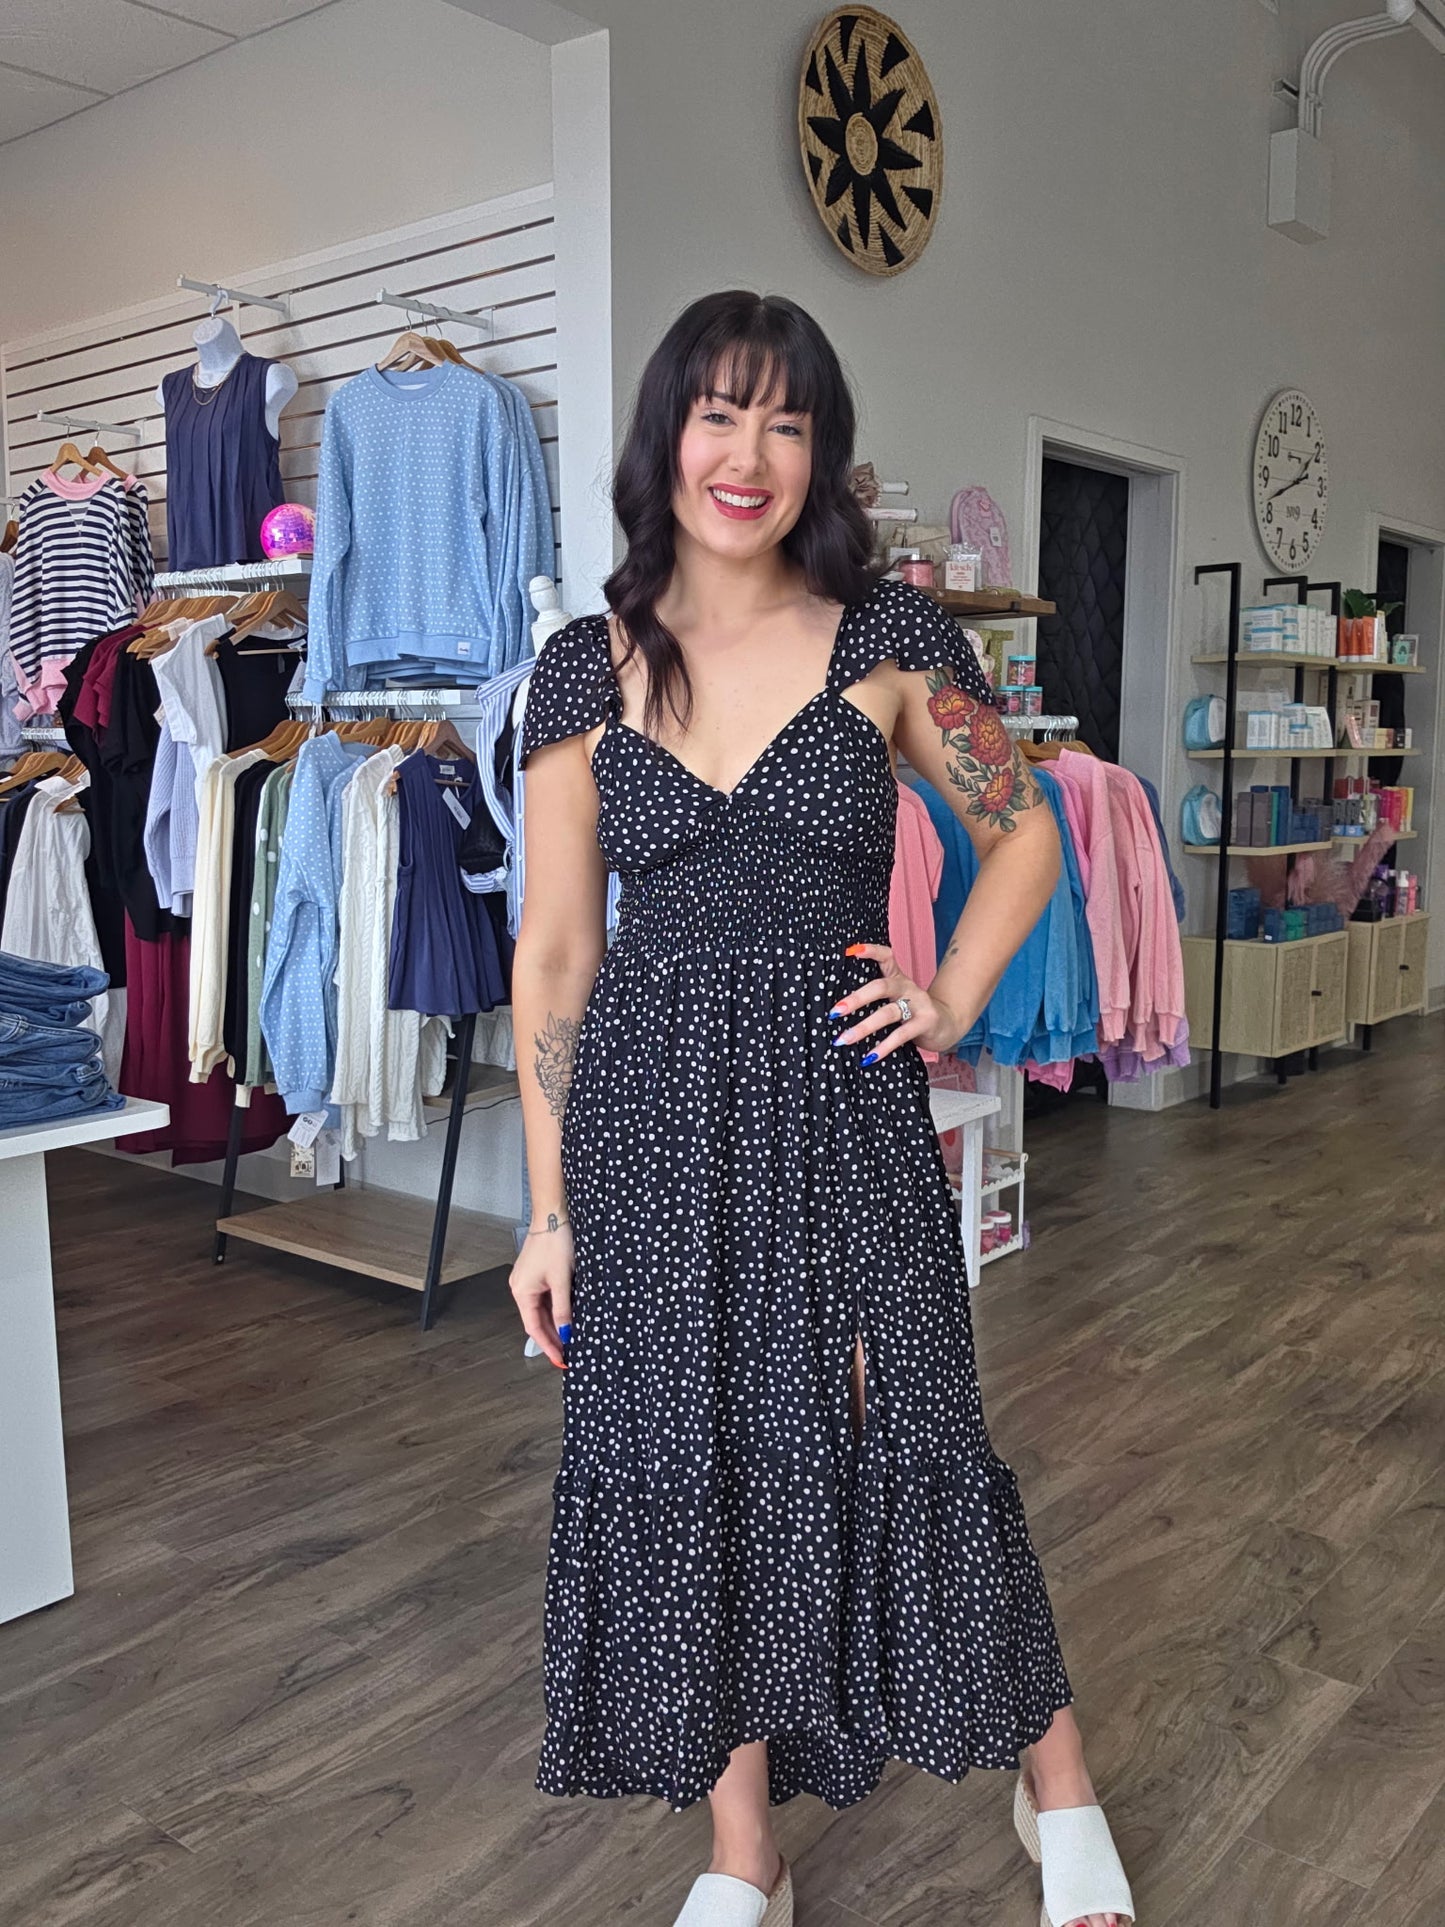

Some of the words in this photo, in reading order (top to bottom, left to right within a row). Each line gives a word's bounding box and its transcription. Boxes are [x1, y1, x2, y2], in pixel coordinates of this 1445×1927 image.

[1278, 411, 1287, 434] 11
[1291, 403, 1302, 427] 12
[1306, 415, 1311, 437] 1
[1267, 434, 1280, 458] 10
[1314, 441, 1321, 463] 2
[1262, 465, 1270, 488] 9
[1317, 476, 1323, 498] 3
[1266, 501, 1273, 524] 8
[1311, 508, 1318, 529] 4
[1276, 526, 1283, 549] 7
[1302, 531, 1309, 553] 5
[1289, 538, 1296, 560] 6
